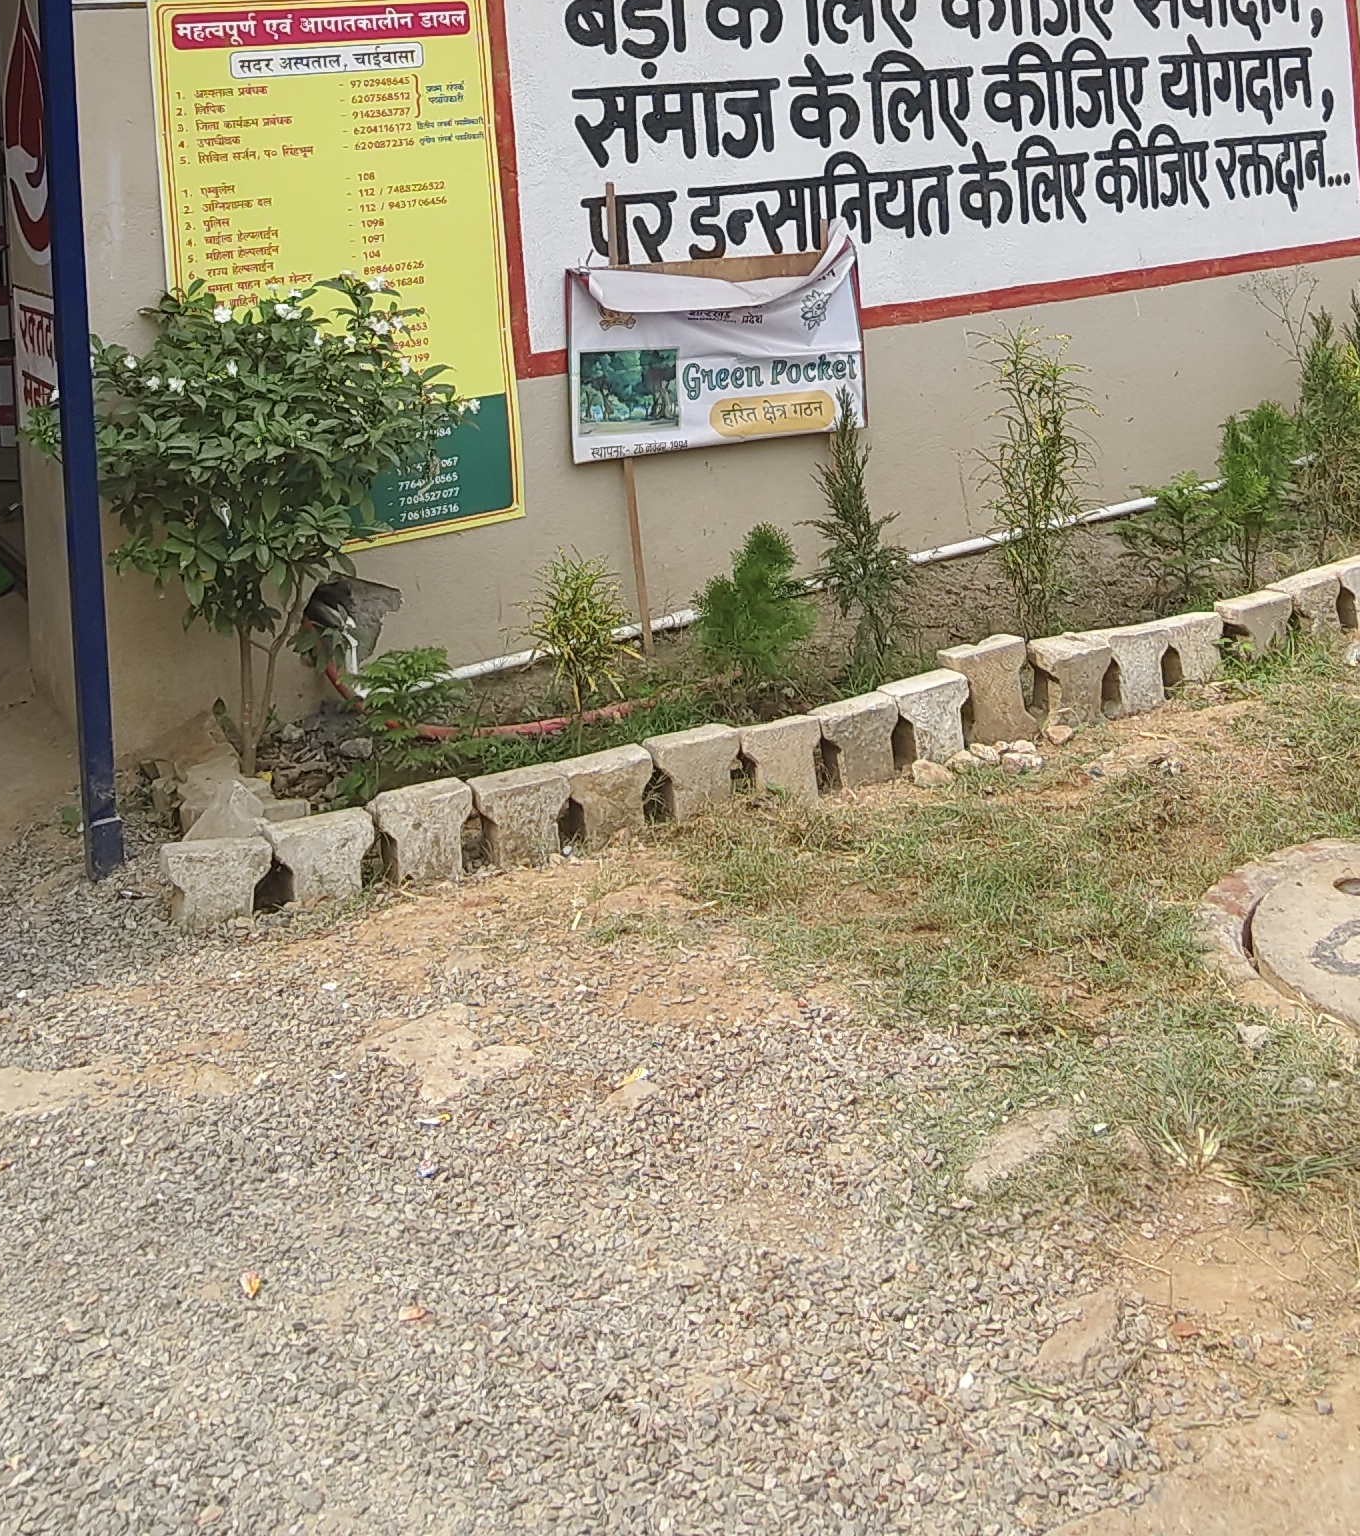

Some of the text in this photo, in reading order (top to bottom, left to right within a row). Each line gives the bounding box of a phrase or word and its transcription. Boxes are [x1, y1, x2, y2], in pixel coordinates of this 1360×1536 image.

[175, 8, 467, 45] महत्वपूर्ण एवं आपातकालीन डायल
[238, 56, 273, 73] सदर
[573, 77, 779, 169] समाज
[789, 53, 863, 149] के
[862, 49, 972, 148] लिए
[982, 39, 1149, 135] कीजिए
[357, 172, 376, 182] 108
[960, 140, 1013, 230] के
[1010, 134, 1089, 226] लिए
[1095, 123, 1209, 211] कीजिए
[682, 353, 858, 401] Green Pocket
[720, 403, 759, 428] हरित
